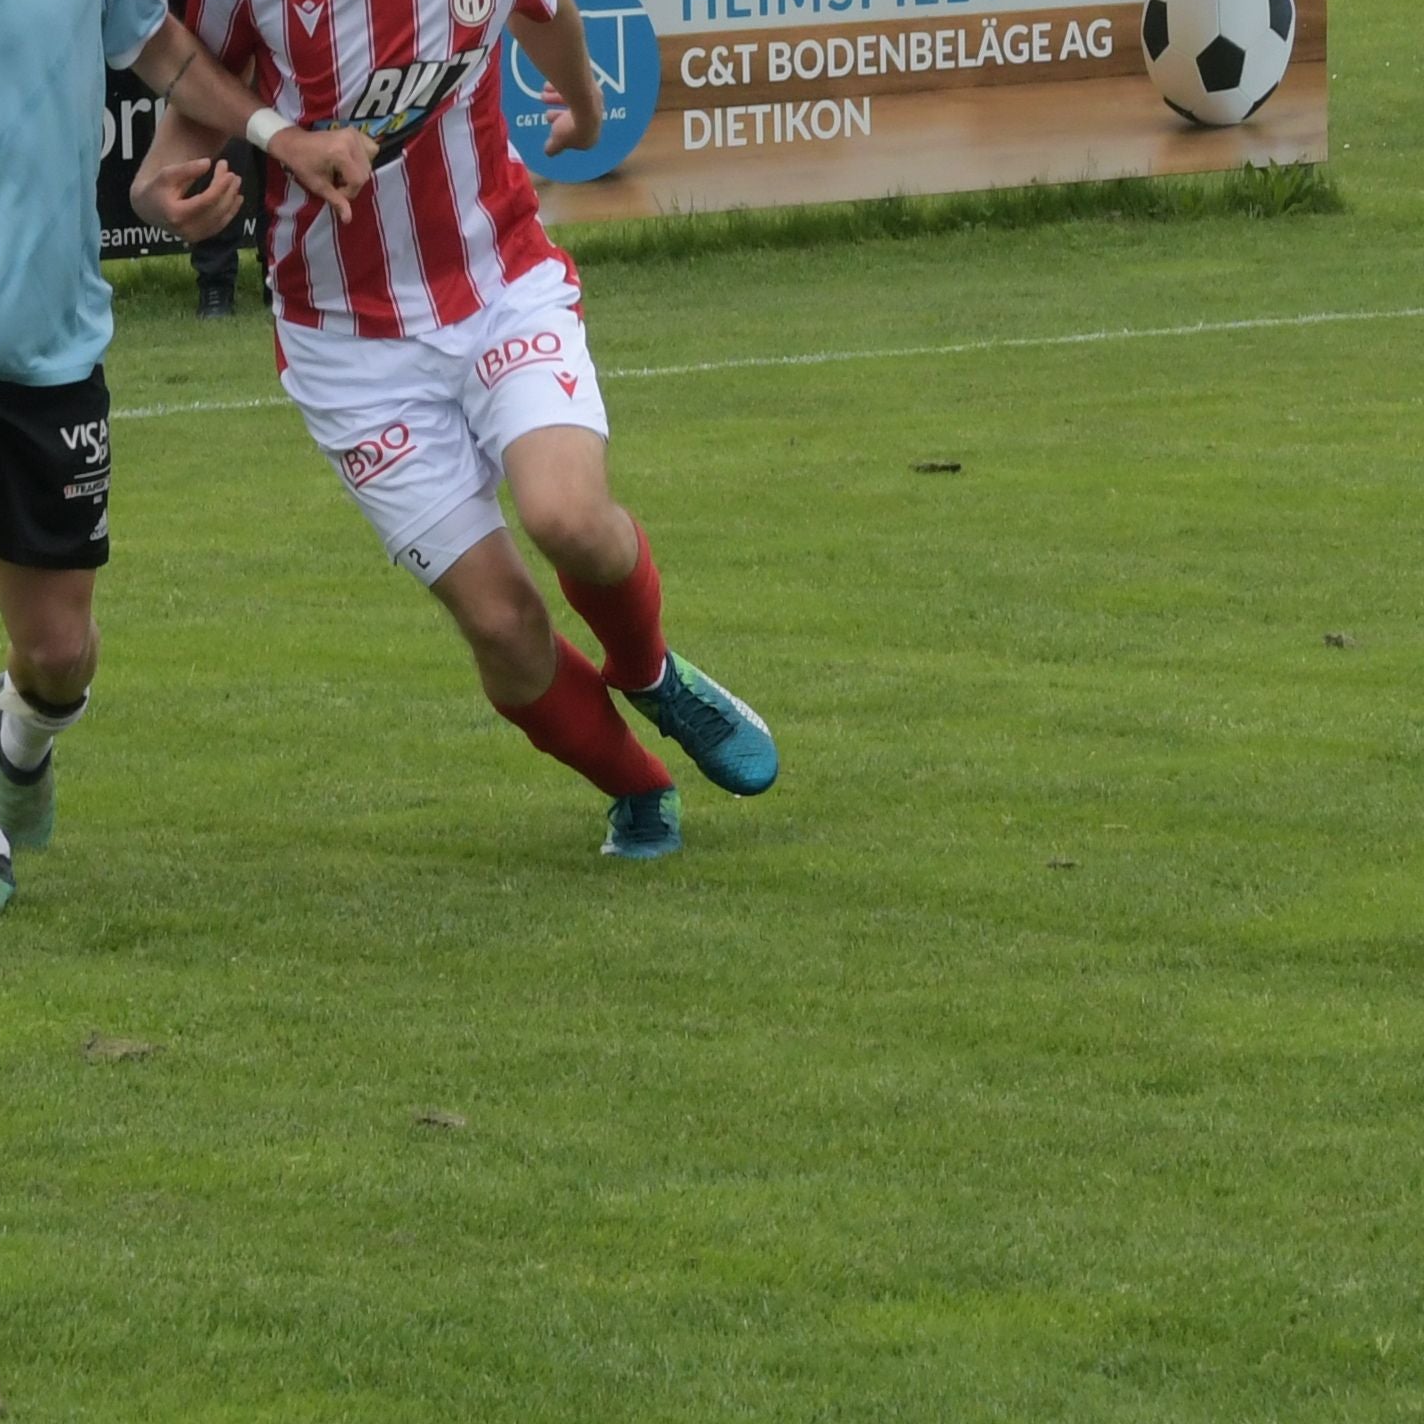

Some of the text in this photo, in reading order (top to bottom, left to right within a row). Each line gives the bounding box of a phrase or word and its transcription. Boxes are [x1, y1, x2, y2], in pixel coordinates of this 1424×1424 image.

[680, 17, 1114, 89] C&T BODENBELÄGE AG
[682, 96, 872, 151] DIETIKON
[479, 331, 563, 379] BDO
[343, 422, 410, 479] BDO
[408, 547, 431, 570] 2
